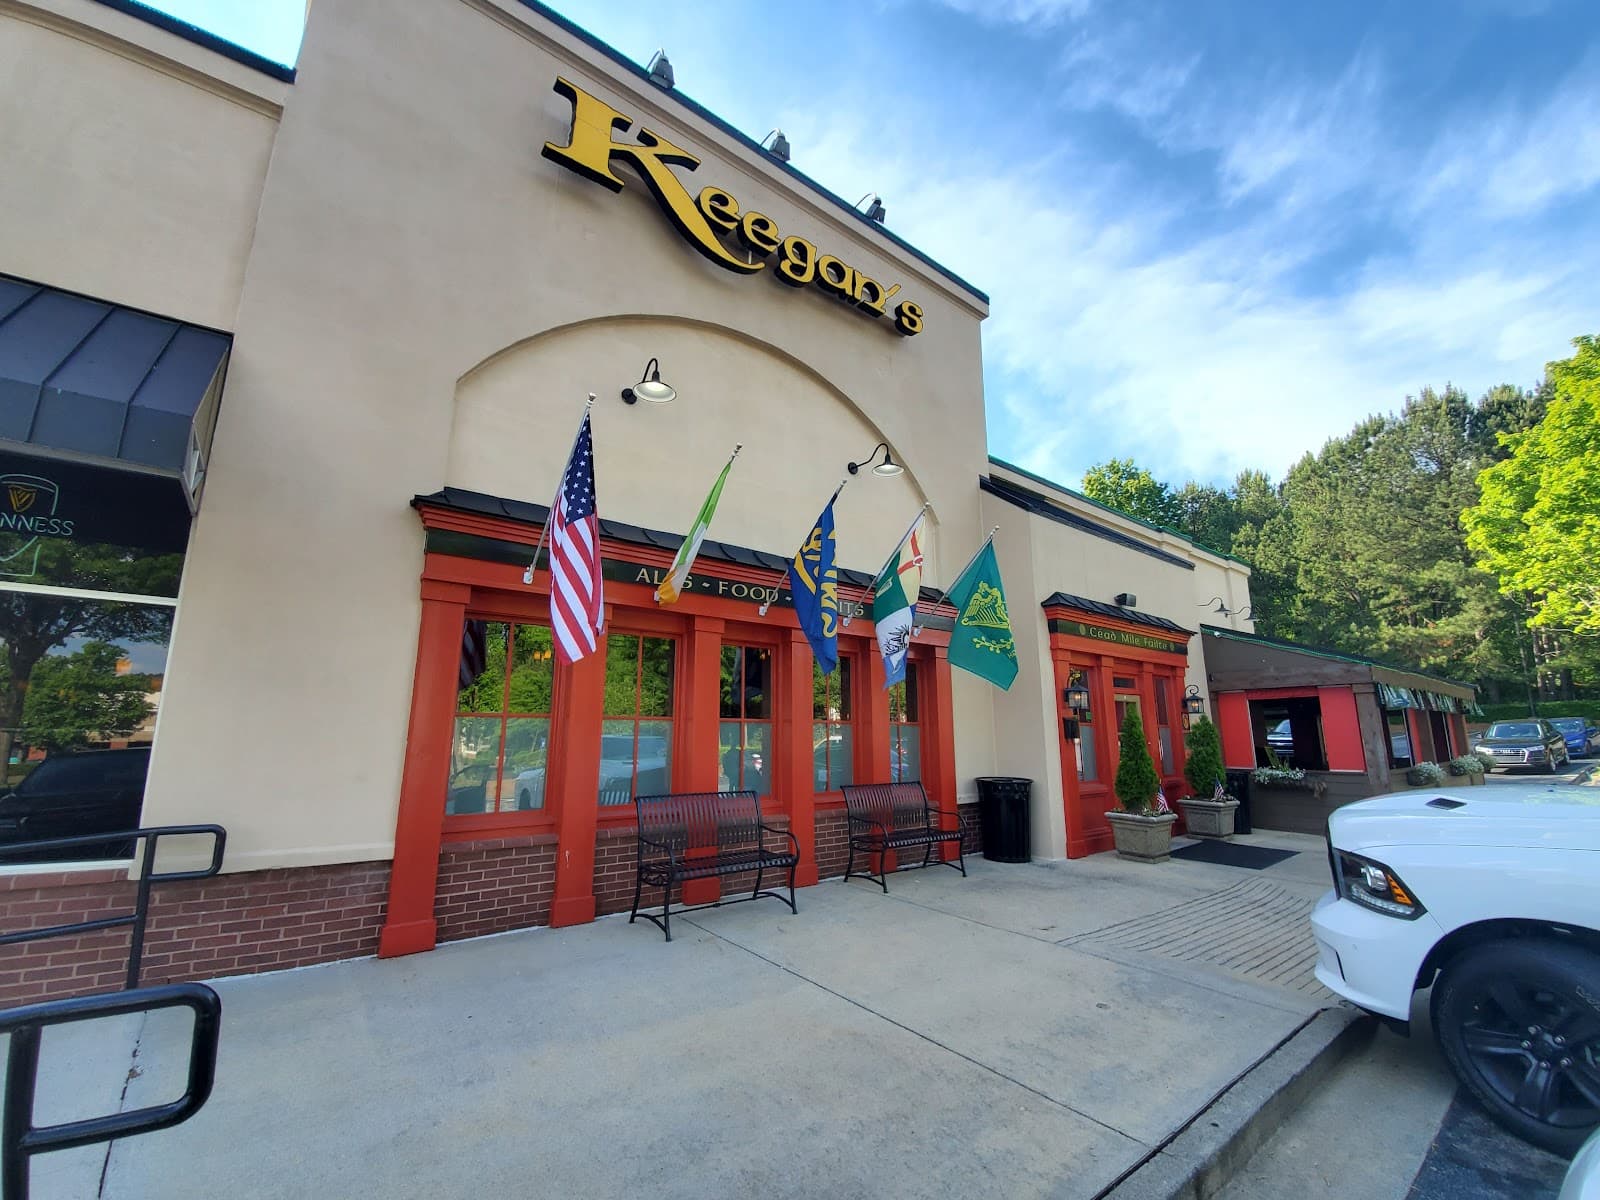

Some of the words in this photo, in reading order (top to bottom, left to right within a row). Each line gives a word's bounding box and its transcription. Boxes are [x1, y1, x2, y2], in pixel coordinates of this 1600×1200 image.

[541, 75, 924, 337] Keegan's
[0, 511, 75, 536] NNESS
[635, 567, 693, 589] ALS
[718, 581, 779, 602] FOOD
